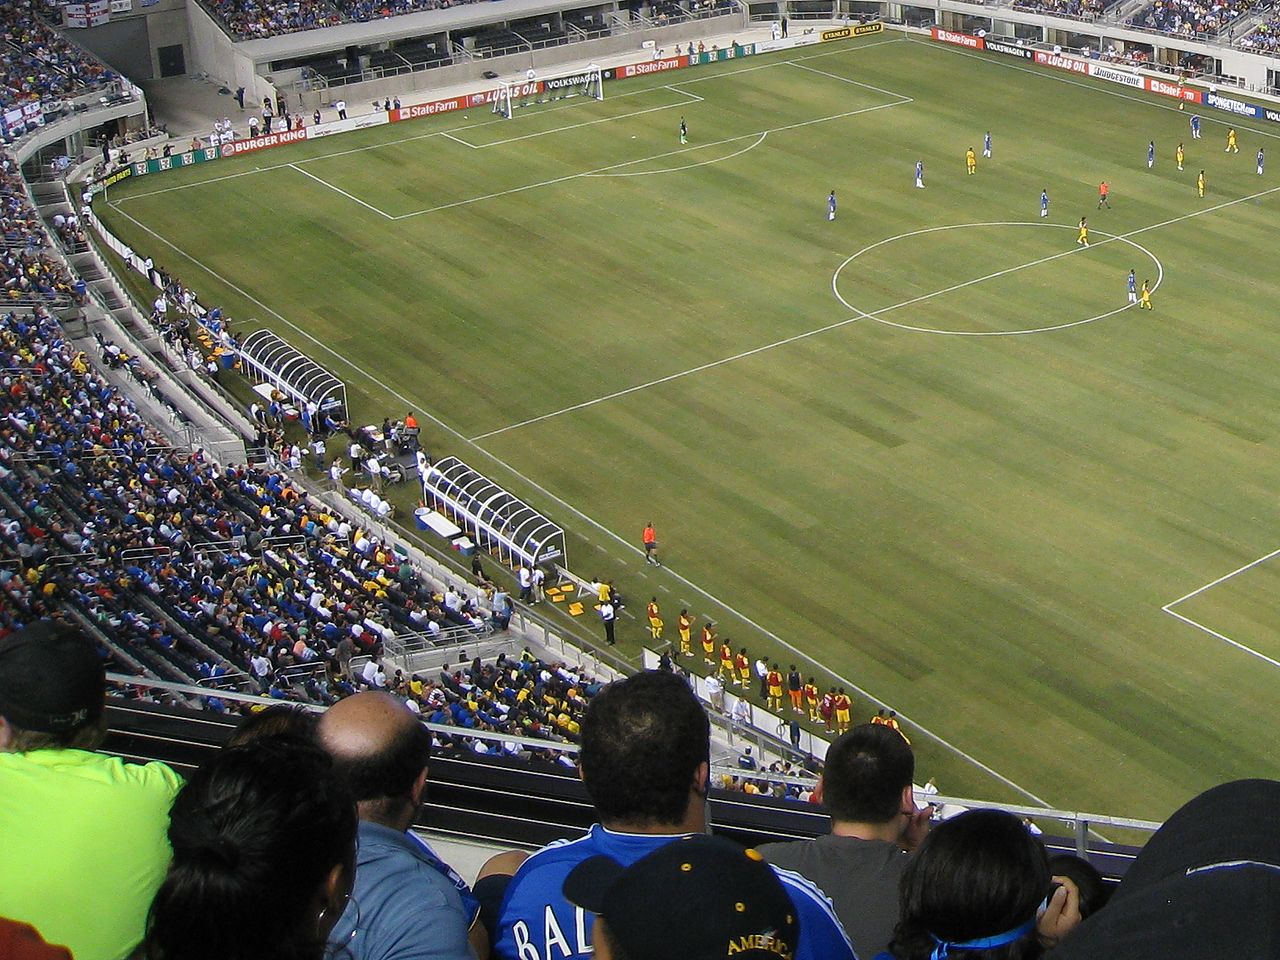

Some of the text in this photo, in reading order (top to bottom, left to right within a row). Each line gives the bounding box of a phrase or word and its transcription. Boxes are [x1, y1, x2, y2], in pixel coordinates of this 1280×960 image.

[986, 41, 1025, 58] VOLKSWAGEN
[1047, 55, 1086, 73] LUCAS OIL
[548, 72, 600, 89] VOLKSWAGEN
[1094, 66, 1141, 89] BRIDGESTONE
[522, 82, 538, 96] OIL
[235, 136, 278, 152] BURGER
[279, 128, 306, 143] KING
[117, 167, 131, 181] PARTS
